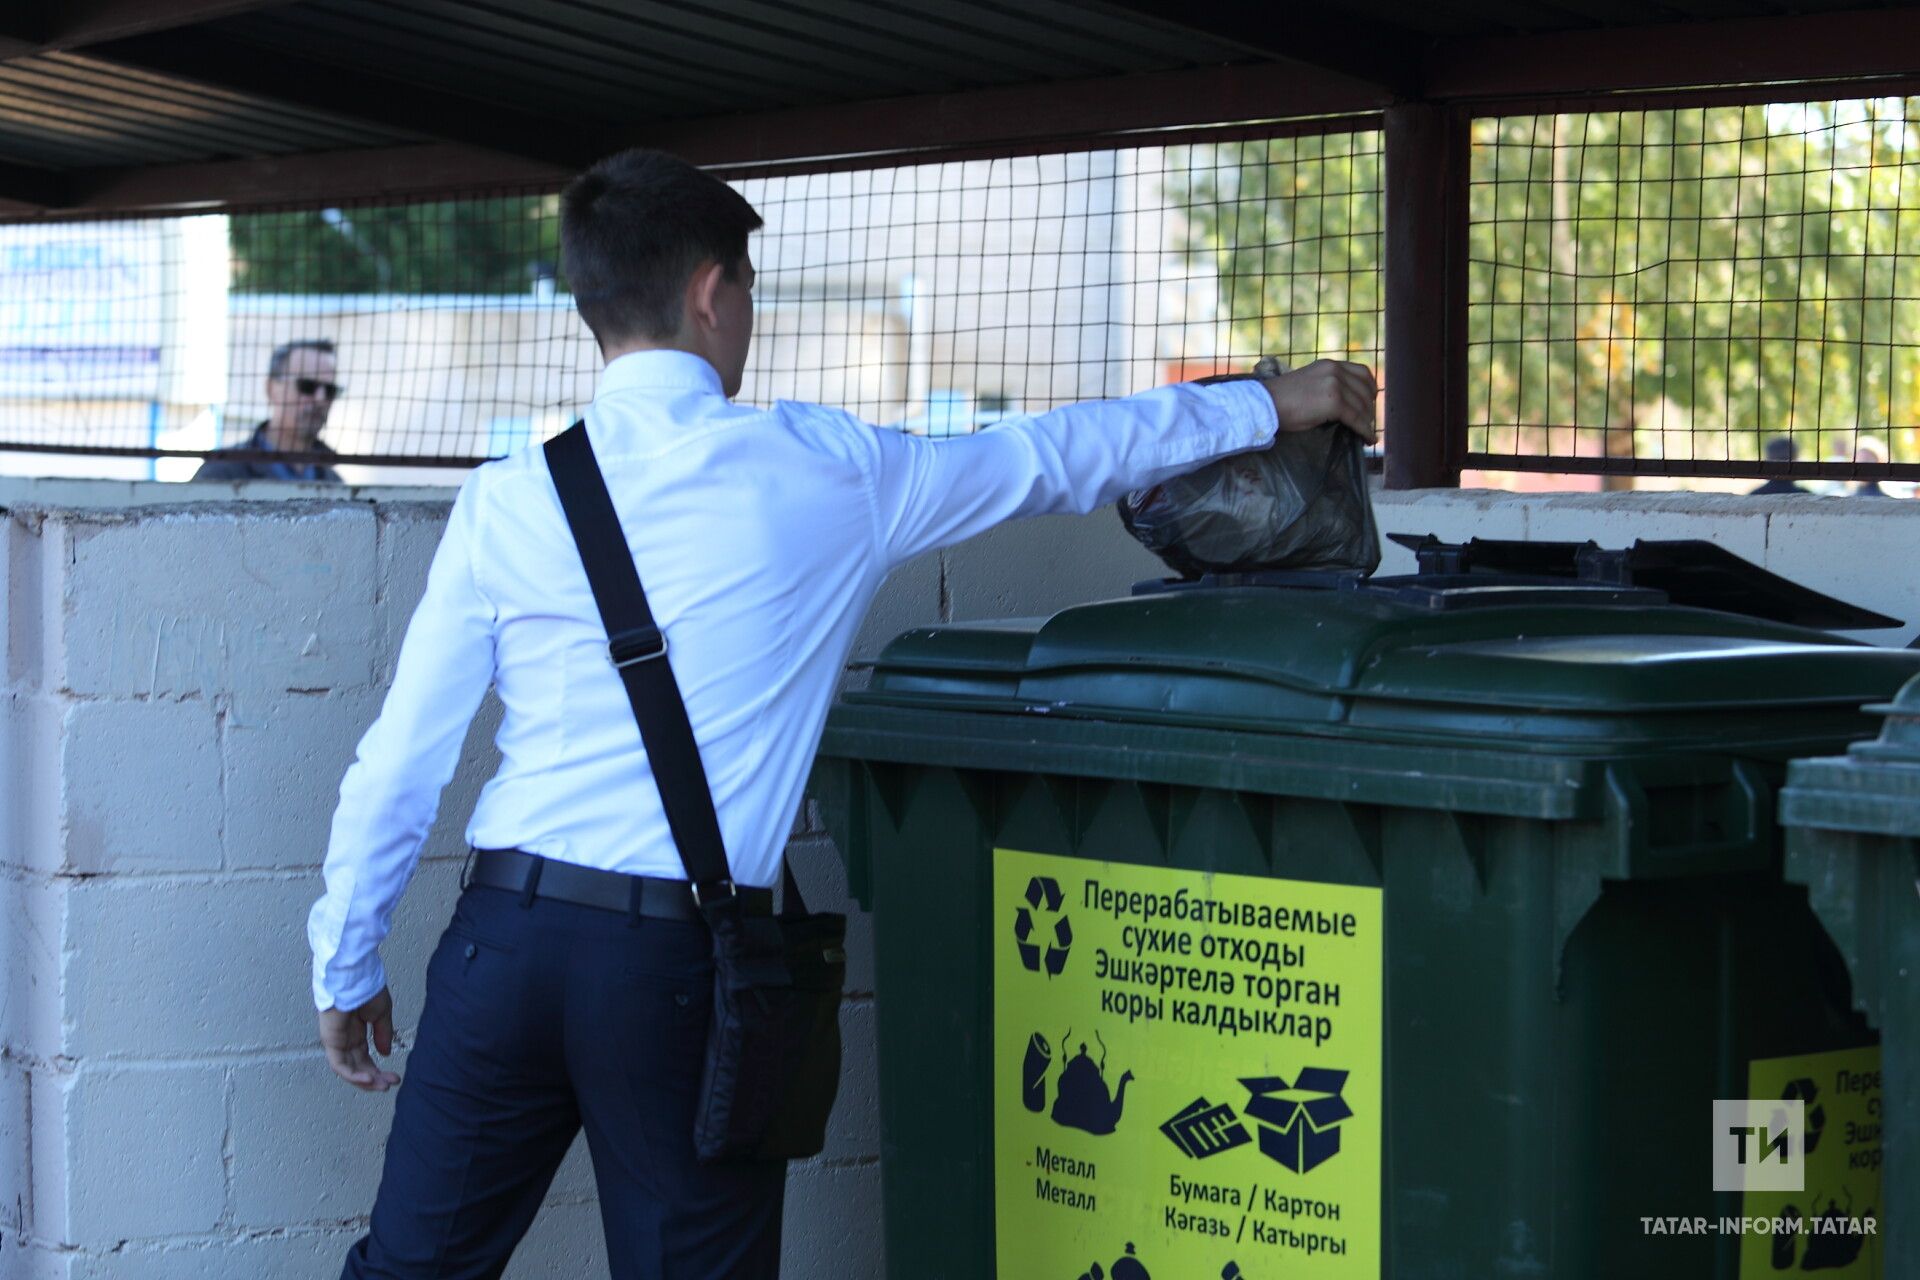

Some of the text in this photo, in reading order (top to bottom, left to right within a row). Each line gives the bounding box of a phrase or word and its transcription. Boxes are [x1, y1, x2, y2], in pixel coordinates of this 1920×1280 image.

[1084, 879, 1356, 937] Перерабатываемые
[1122, 925, 1304, 972] сухие отходы
[1095, 948, 1340, 1008] Эшкәртелә торган
[1101, 989, 1332, 1047] коры калдыклар
[1035, 1145, 1096, 1181] Металл
[1035, 1176, 1096, 1212] Металл
[1170, 1174, 1241, 1206] Бумага
[1264, 1188, 1340, 1221] Картон
[1165, 1205, 1231, 1238] Кәгазь
[1253, 1220, 1346, 1255] Катыргы
